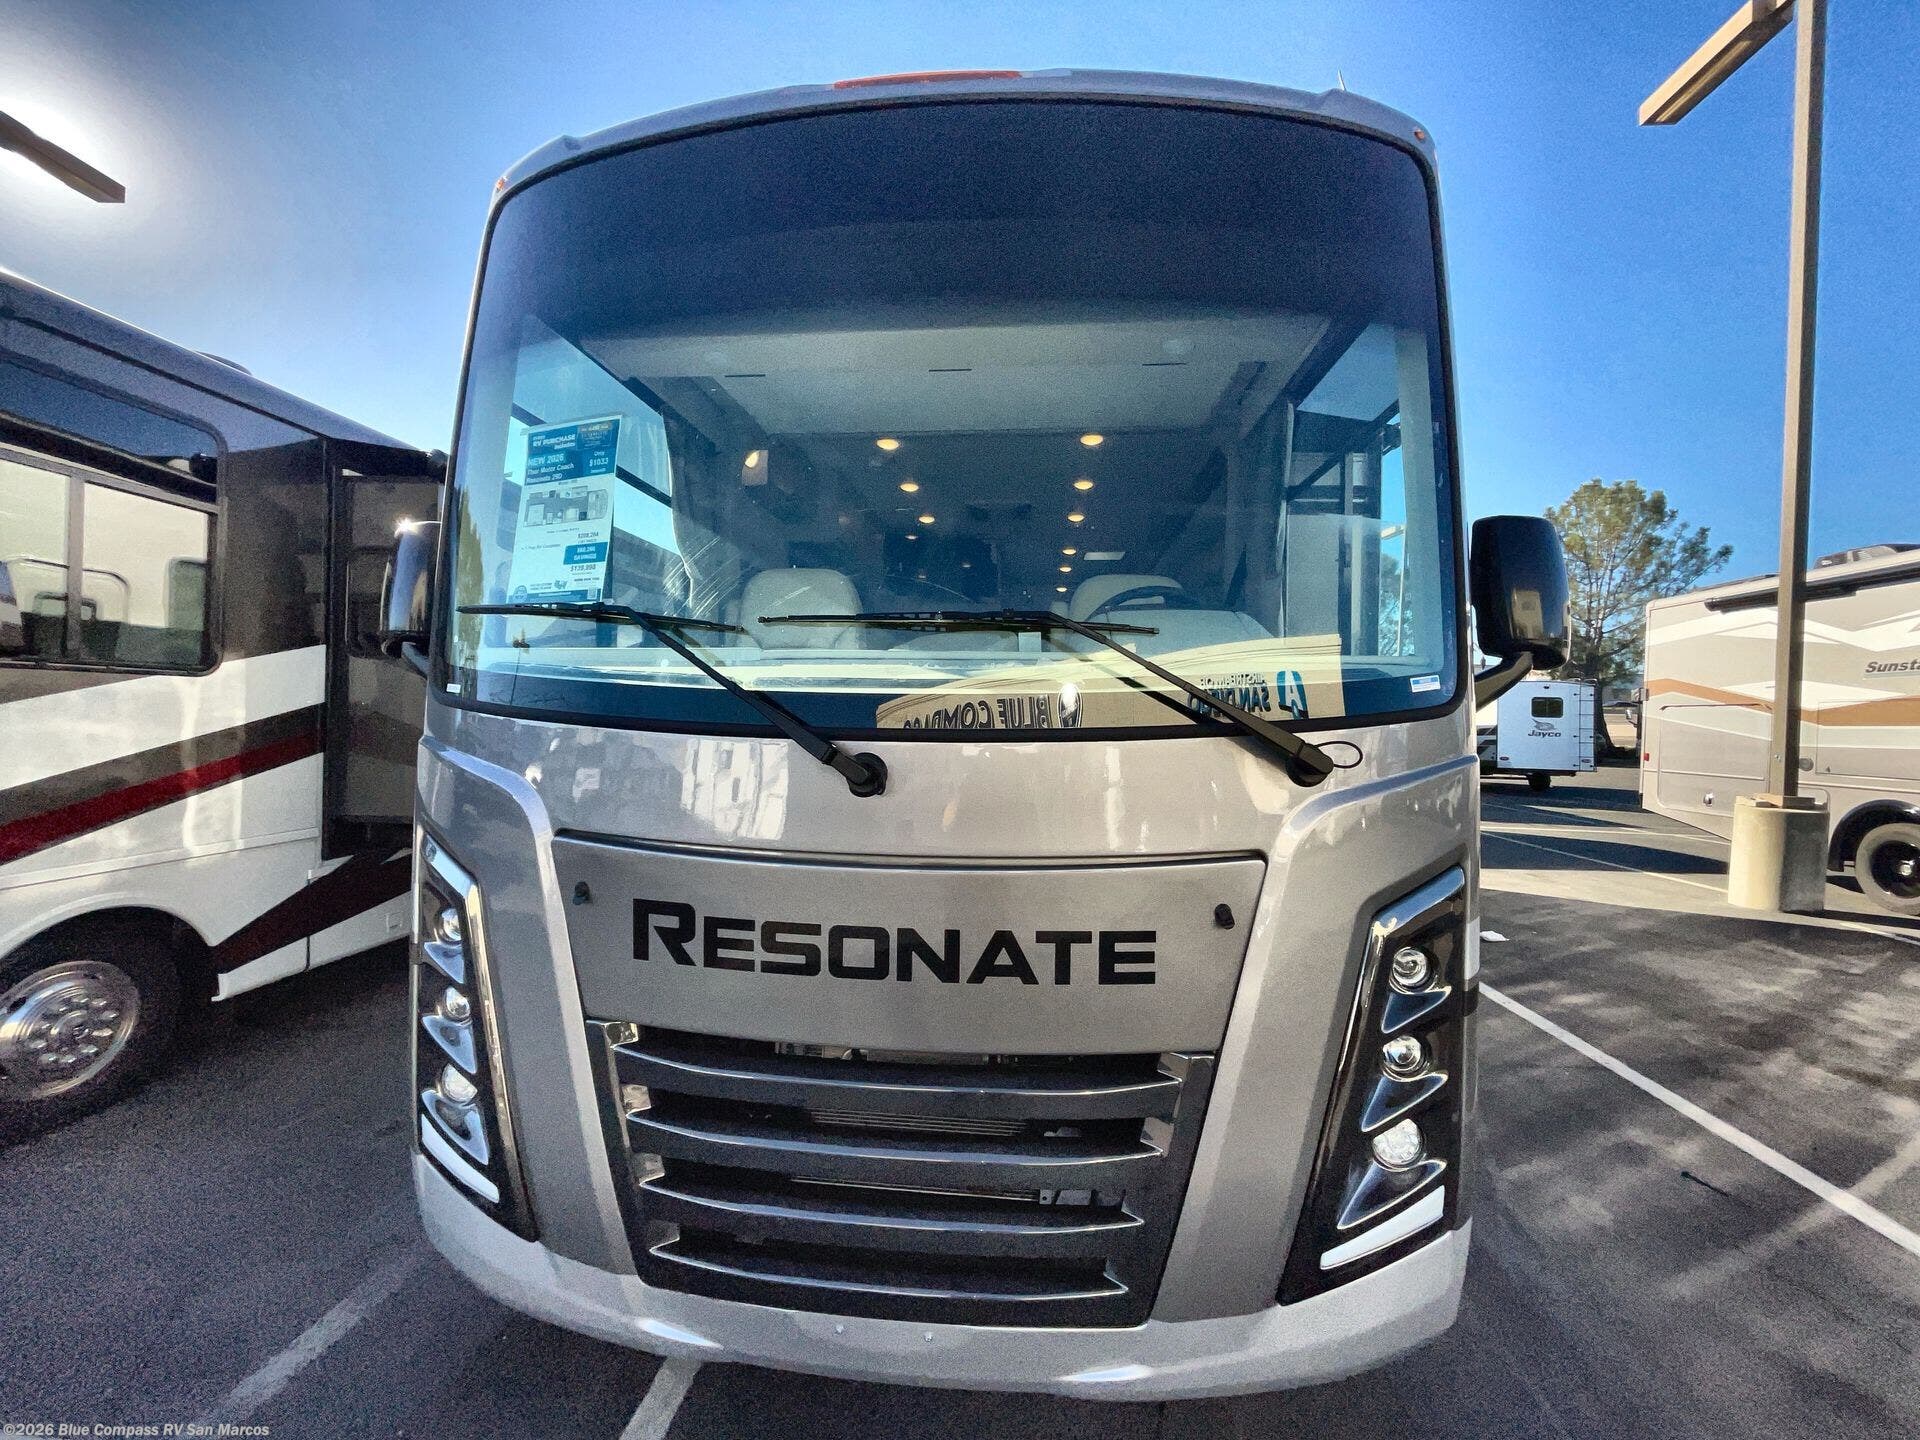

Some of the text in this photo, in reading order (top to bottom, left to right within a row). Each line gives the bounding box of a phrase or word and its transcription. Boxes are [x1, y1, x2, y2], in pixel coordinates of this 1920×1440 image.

[543, 434, 576, 445] PURCHASE
[528, 456, 546, 466] NEW
[1528, 730, 1562, 738] Jayco
[633, 898, 1157, 985] RESONATE
